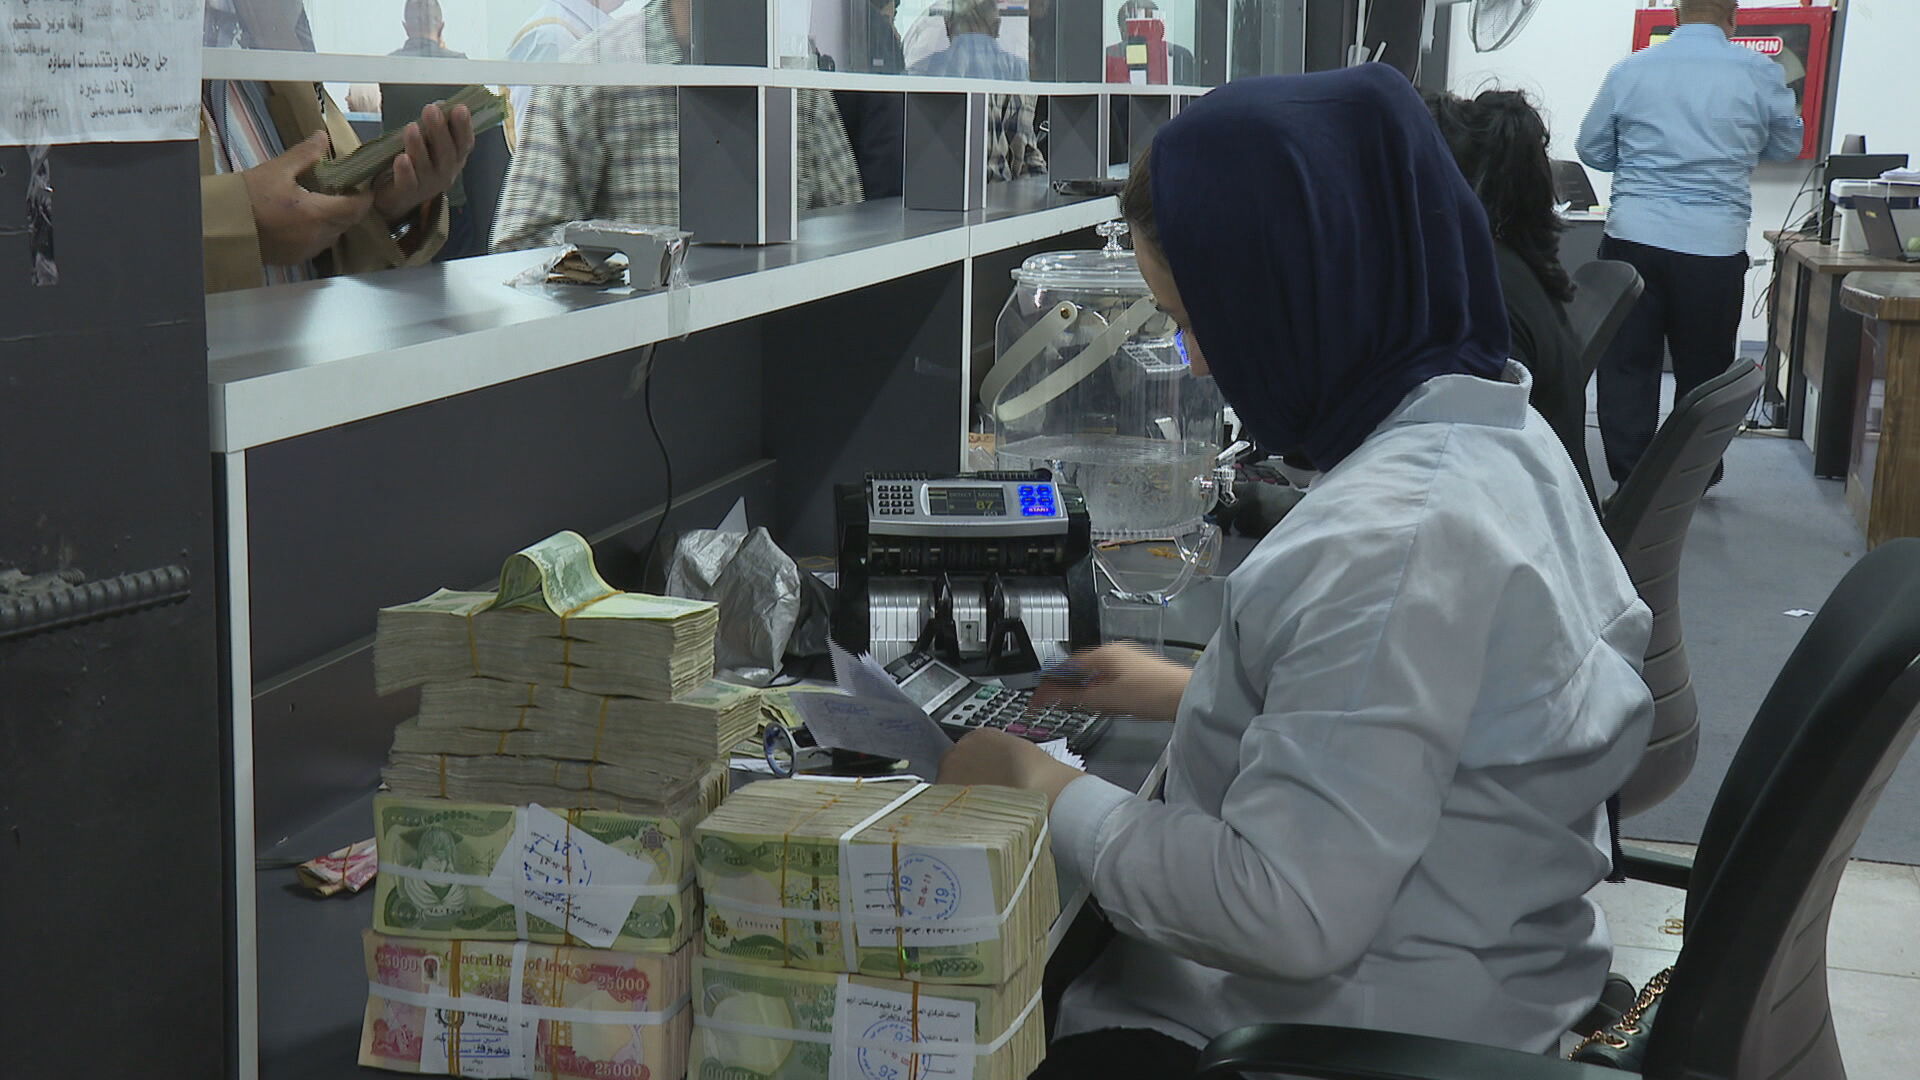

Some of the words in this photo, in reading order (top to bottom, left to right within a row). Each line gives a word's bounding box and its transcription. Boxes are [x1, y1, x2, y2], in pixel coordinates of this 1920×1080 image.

[377, 953, 418, 972] 25000
[444, 951, 493, 967] Cntral
[597, 976, 645, 991] 25000
[595, 1062, 642, 1078] 25000
